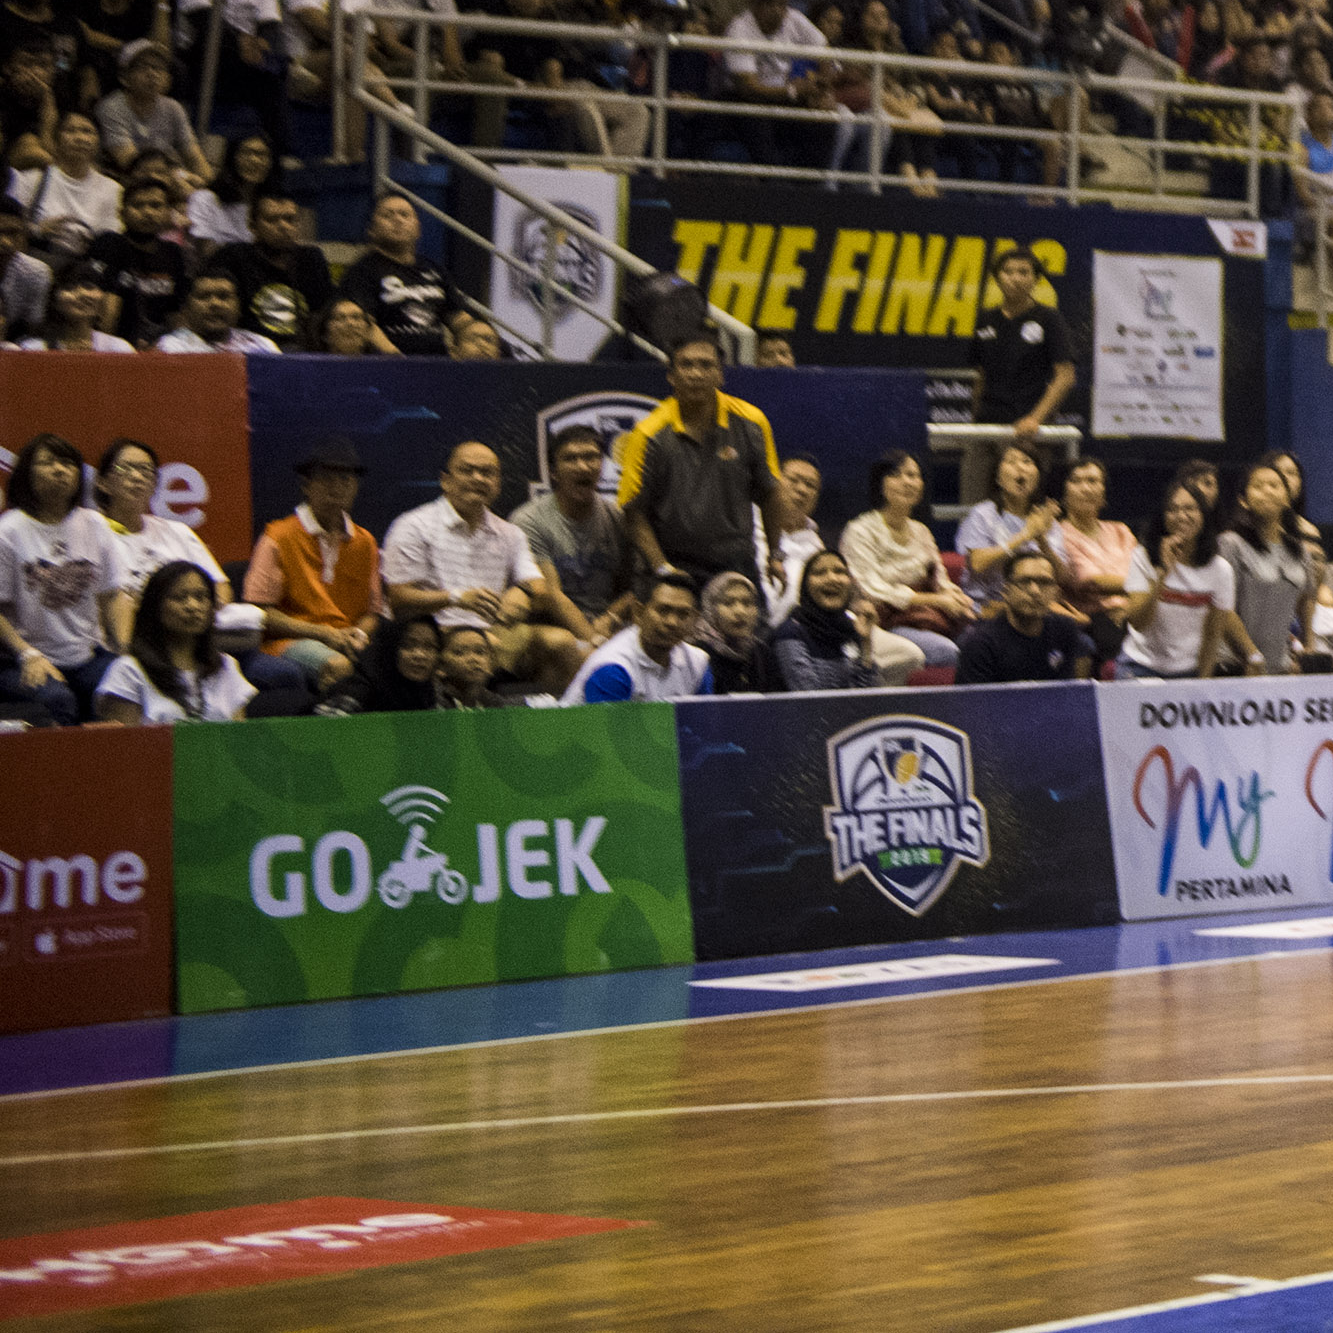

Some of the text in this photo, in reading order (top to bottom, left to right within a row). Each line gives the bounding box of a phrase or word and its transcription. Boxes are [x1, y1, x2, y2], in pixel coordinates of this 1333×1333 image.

[673, 220, 817, 331] THE
[1139, 698, 1295, 730] DOWNLOAD
[249, 816, 613, 918] GO JEK
[833, 804, 982, 869] THE FINALS
[1175, 873, 1293, 902] PERTAMINA
